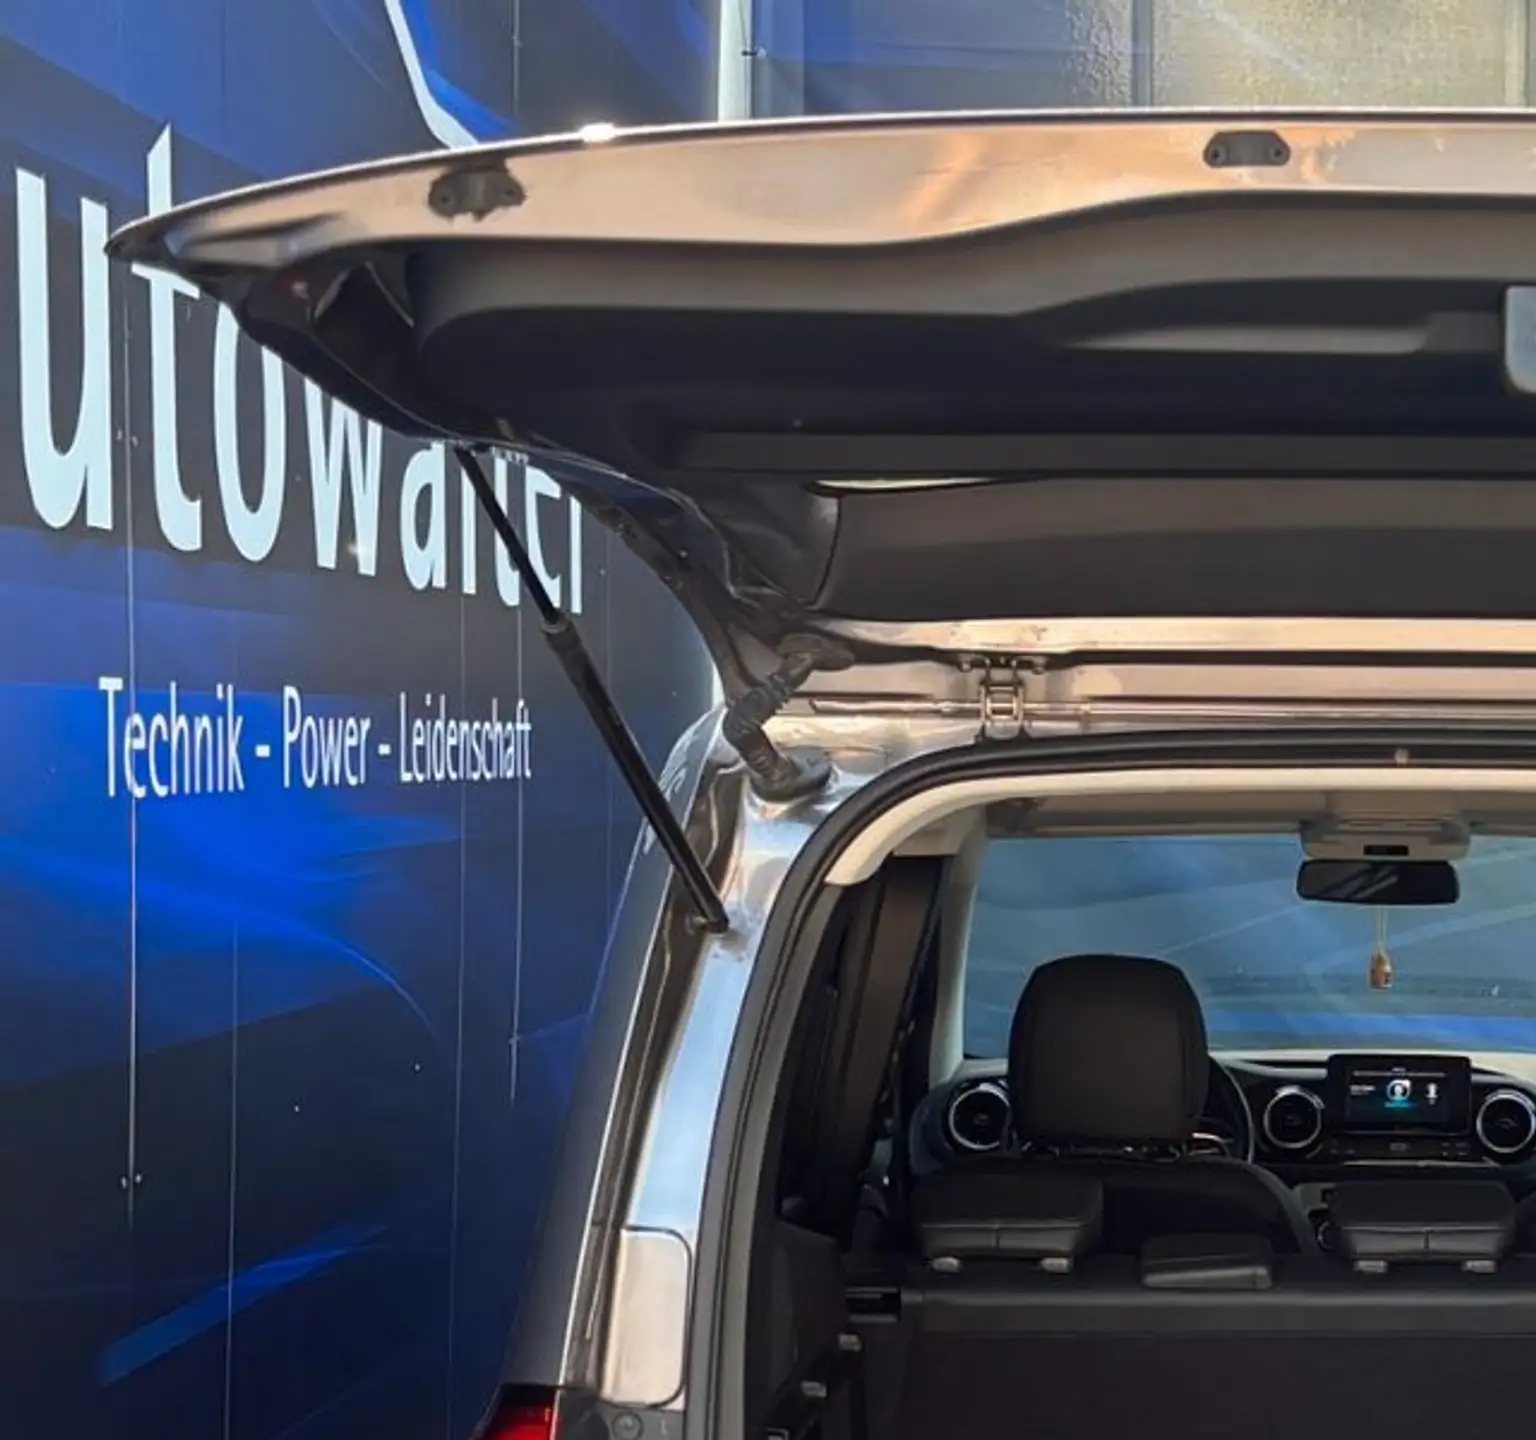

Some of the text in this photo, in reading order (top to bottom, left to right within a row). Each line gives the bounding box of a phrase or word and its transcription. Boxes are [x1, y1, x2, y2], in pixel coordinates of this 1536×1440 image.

[99, 677, 244, 798] Technik
[283, 685, 371, 788] Power
[400, 691, 531, 783] Leidenschaft
